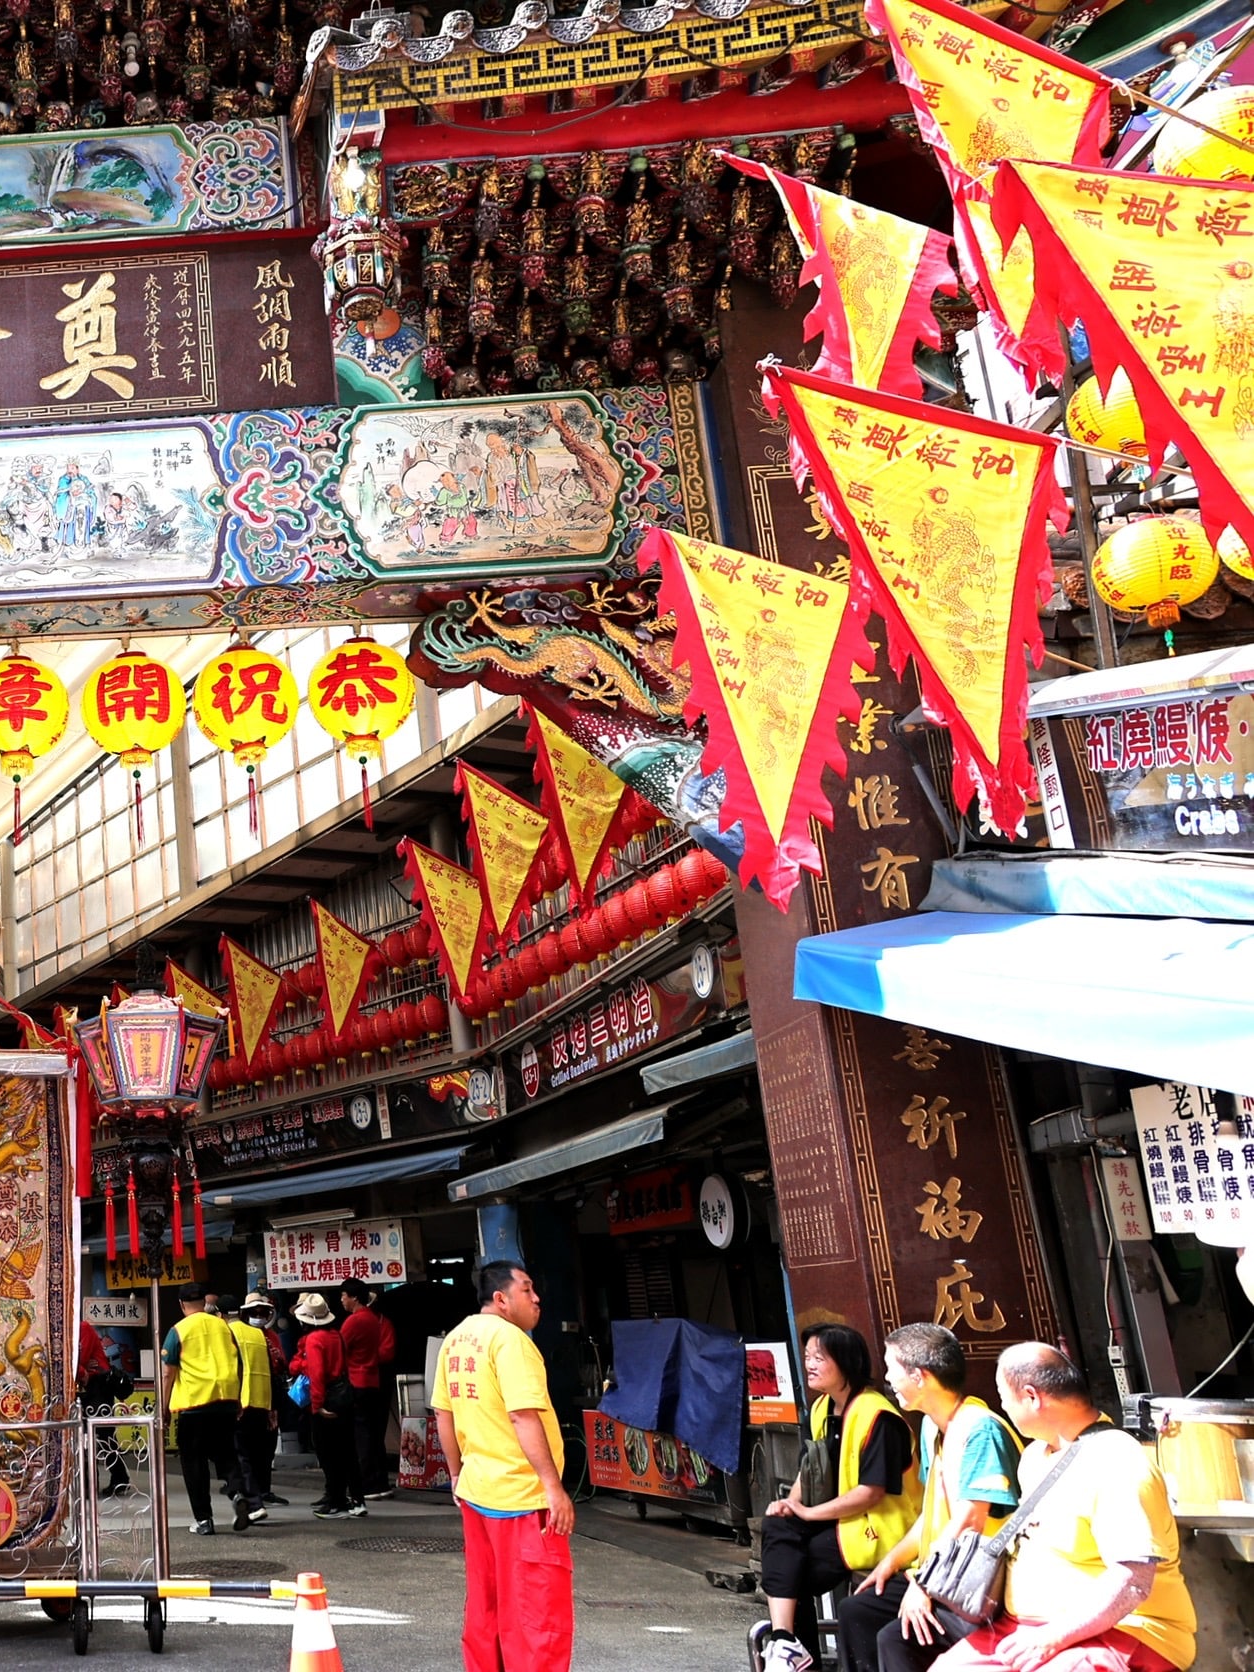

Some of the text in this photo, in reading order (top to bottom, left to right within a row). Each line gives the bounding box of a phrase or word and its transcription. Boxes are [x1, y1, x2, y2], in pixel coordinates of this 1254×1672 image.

[252, 259, 298, 390] 風調雨順
[96, 662, 170, 724] 開
[211, 662, 289, 724] 祝
[317, 648, 397, 717] 恭
[20, 1191, 44, 1223] 基
[1112, 1162, 1143, 1236] 請先付款
[1204, 1207, 1215, 1220] 90
[369, 1231, 381, 1247] 70
[176, 1264, 191, 1281] 220
[300, 1256, 383, 1283] 紅燒鰻焿 90
[89, 1302, 140, 1320] 冷氣開放
